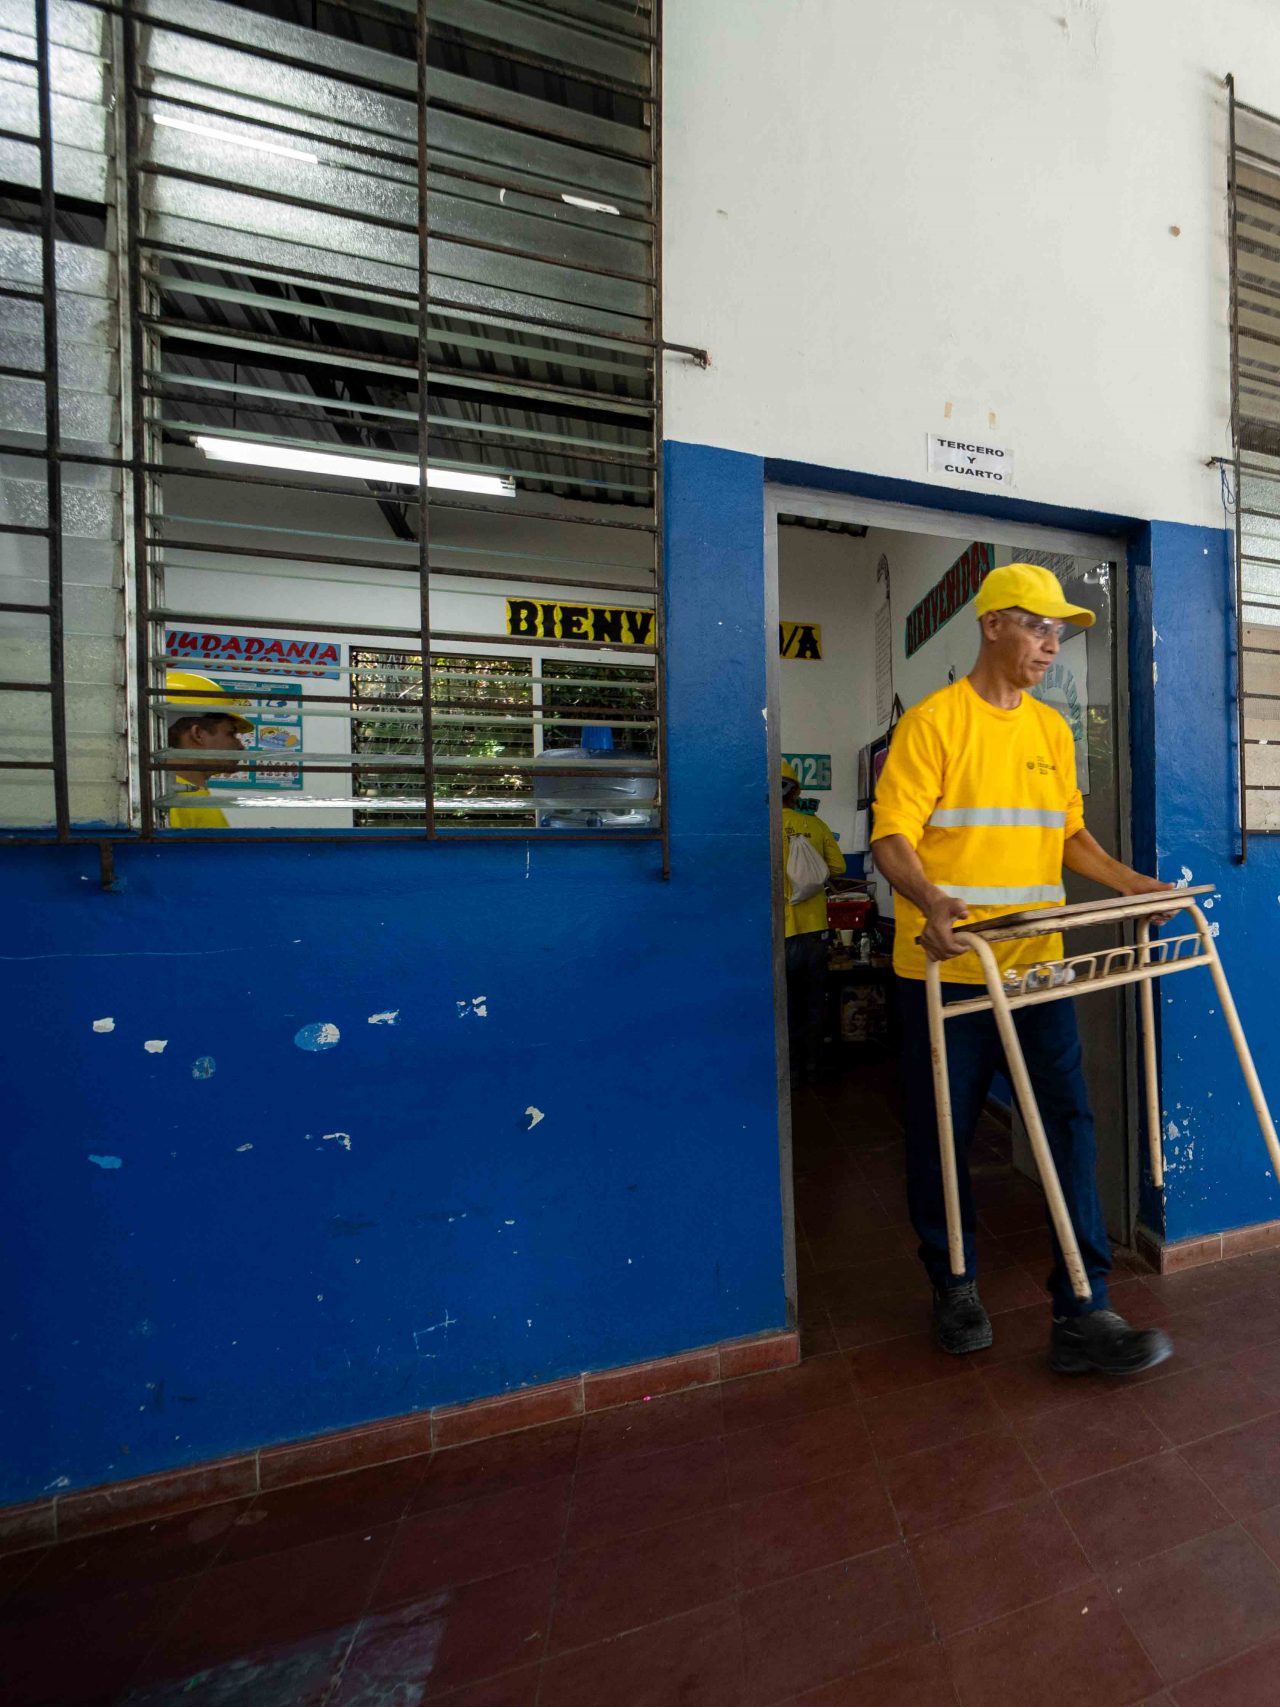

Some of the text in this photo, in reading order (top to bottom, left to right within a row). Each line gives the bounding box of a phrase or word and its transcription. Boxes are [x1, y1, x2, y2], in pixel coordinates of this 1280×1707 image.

[937, 438, 1005, 457] TERCERO
[967, 456, 976, 464] Y
[944, 464, 1003, 481] CUARTO
[166, 631, 338, 662] IUDADANIA
[779, 623, 821, 659] /A
[781, 757, 831, 786] 026
